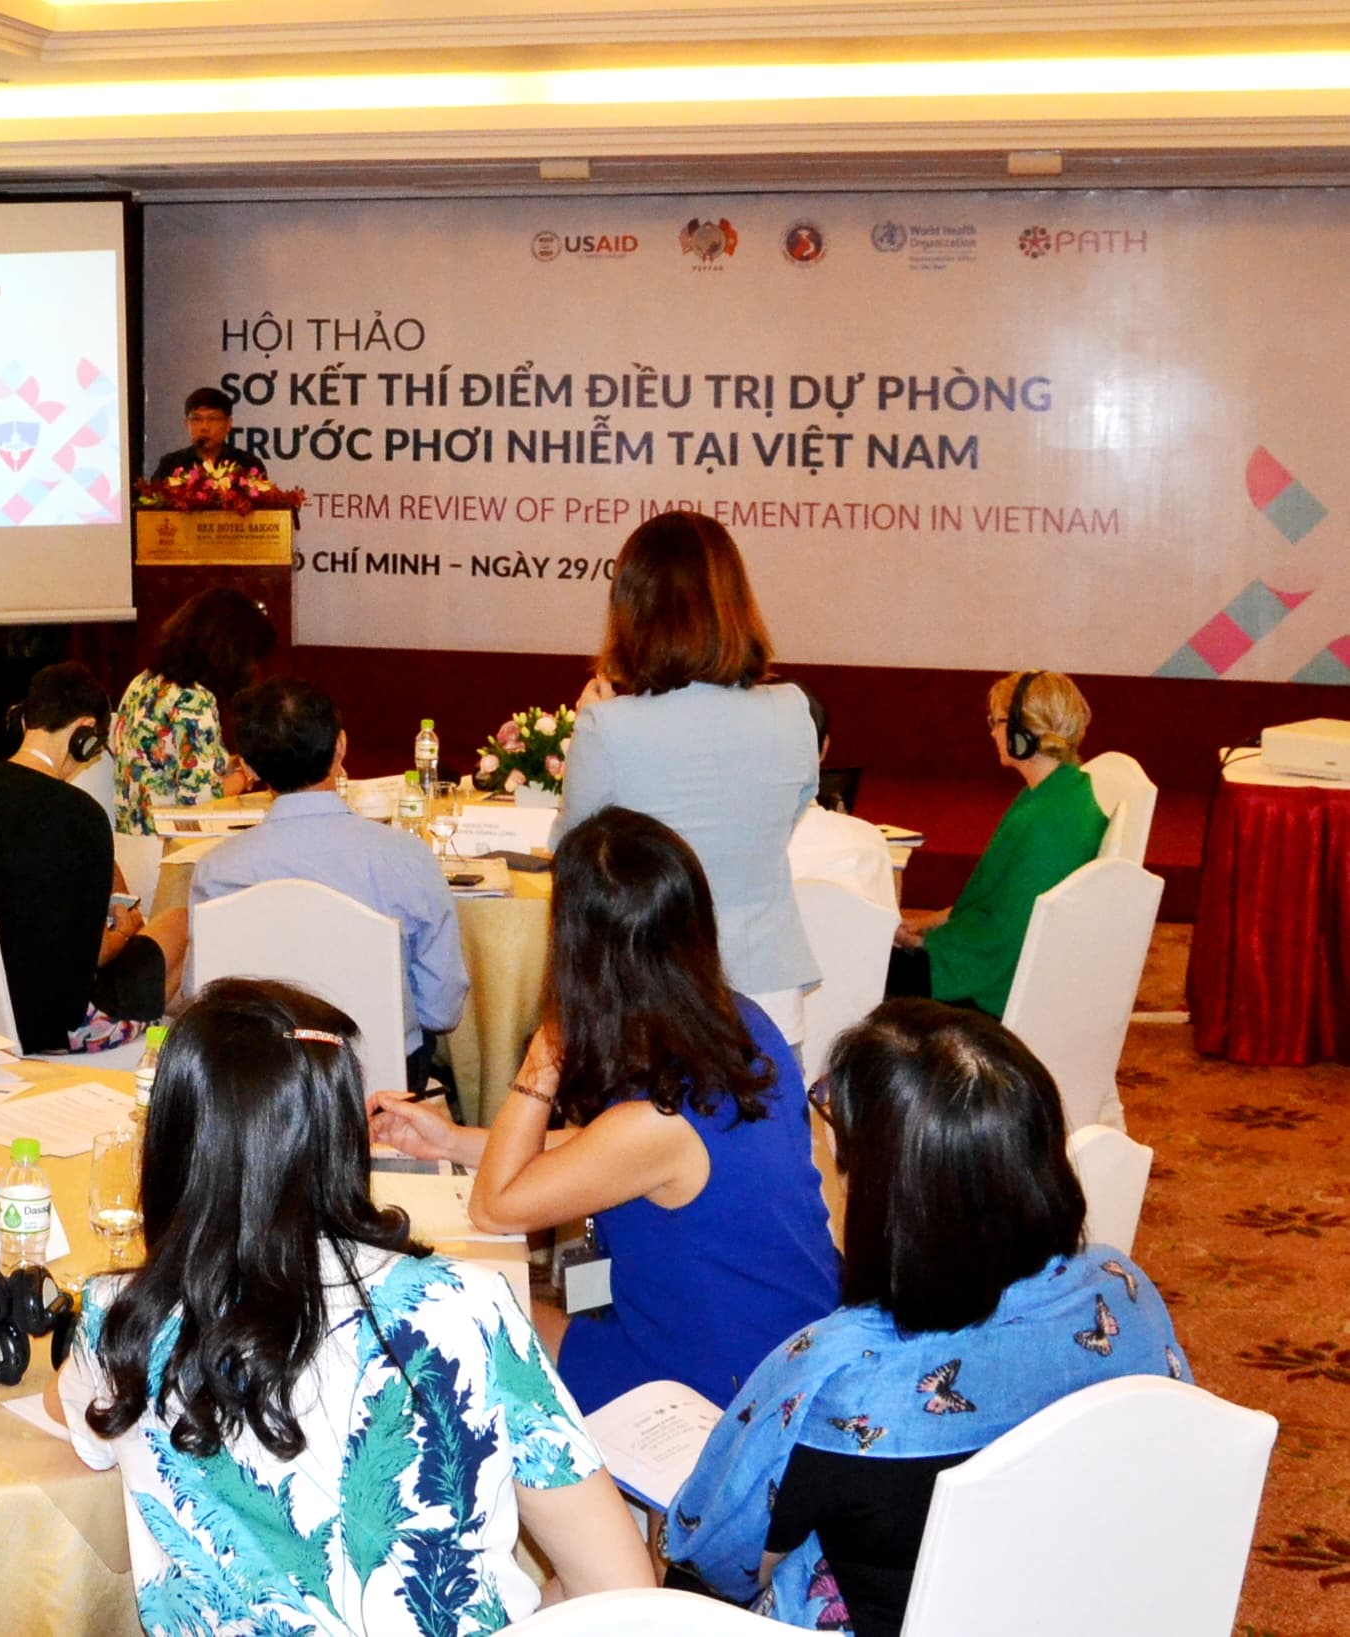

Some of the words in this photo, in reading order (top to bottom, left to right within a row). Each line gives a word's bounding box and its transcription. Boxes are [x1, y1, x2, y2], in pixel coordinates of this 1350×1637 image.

[565, 235, 638, 253] USAID
[910, 225, 940, 236] World
[910, 238, 977, 250] Organization
[1055, 230, 1147, 254] PATH
[222, 311, 293, 359] HỘI
[307, 310, 425, 351] THẢO
[221, 370, 278, 406] SƠ
[290, 362, 367, 406] KẾT
[377, 363, 453, 406] THÍ
[459, 360, 572, 407] ĐIỂM
[585, 362, 691, 408] ĐIỀU
[705, 374, 774, 418] TRỊ
[789, 372, 866, 419] DỰ
[878, 366, 1052, 413] PHÒNG
[385, 426, 492, 462] PHƠI
[508, 414, 653, 465] NHIỄM
[667, 431, 738, 474] TẠI
[752, 425, 853, 476] VIỆT
[867, 434, 979, 470] NAM
[217, 523, 245, 533] HOTEL
[248, 522, 280, 533] SAIGON
[400, 495, 507, 522] REVIEW
[516, 497, 555, 523] OF
[566, 497, 630, 525] PrEP
[931, 504, 962, 531] IN
[972, 505, 1120, 535] VIETNAM
[312, 547, 361, 573] CHÍ
[366, 552, 440, 576] MINH
[471, 551, 550, 579] NGÀY
